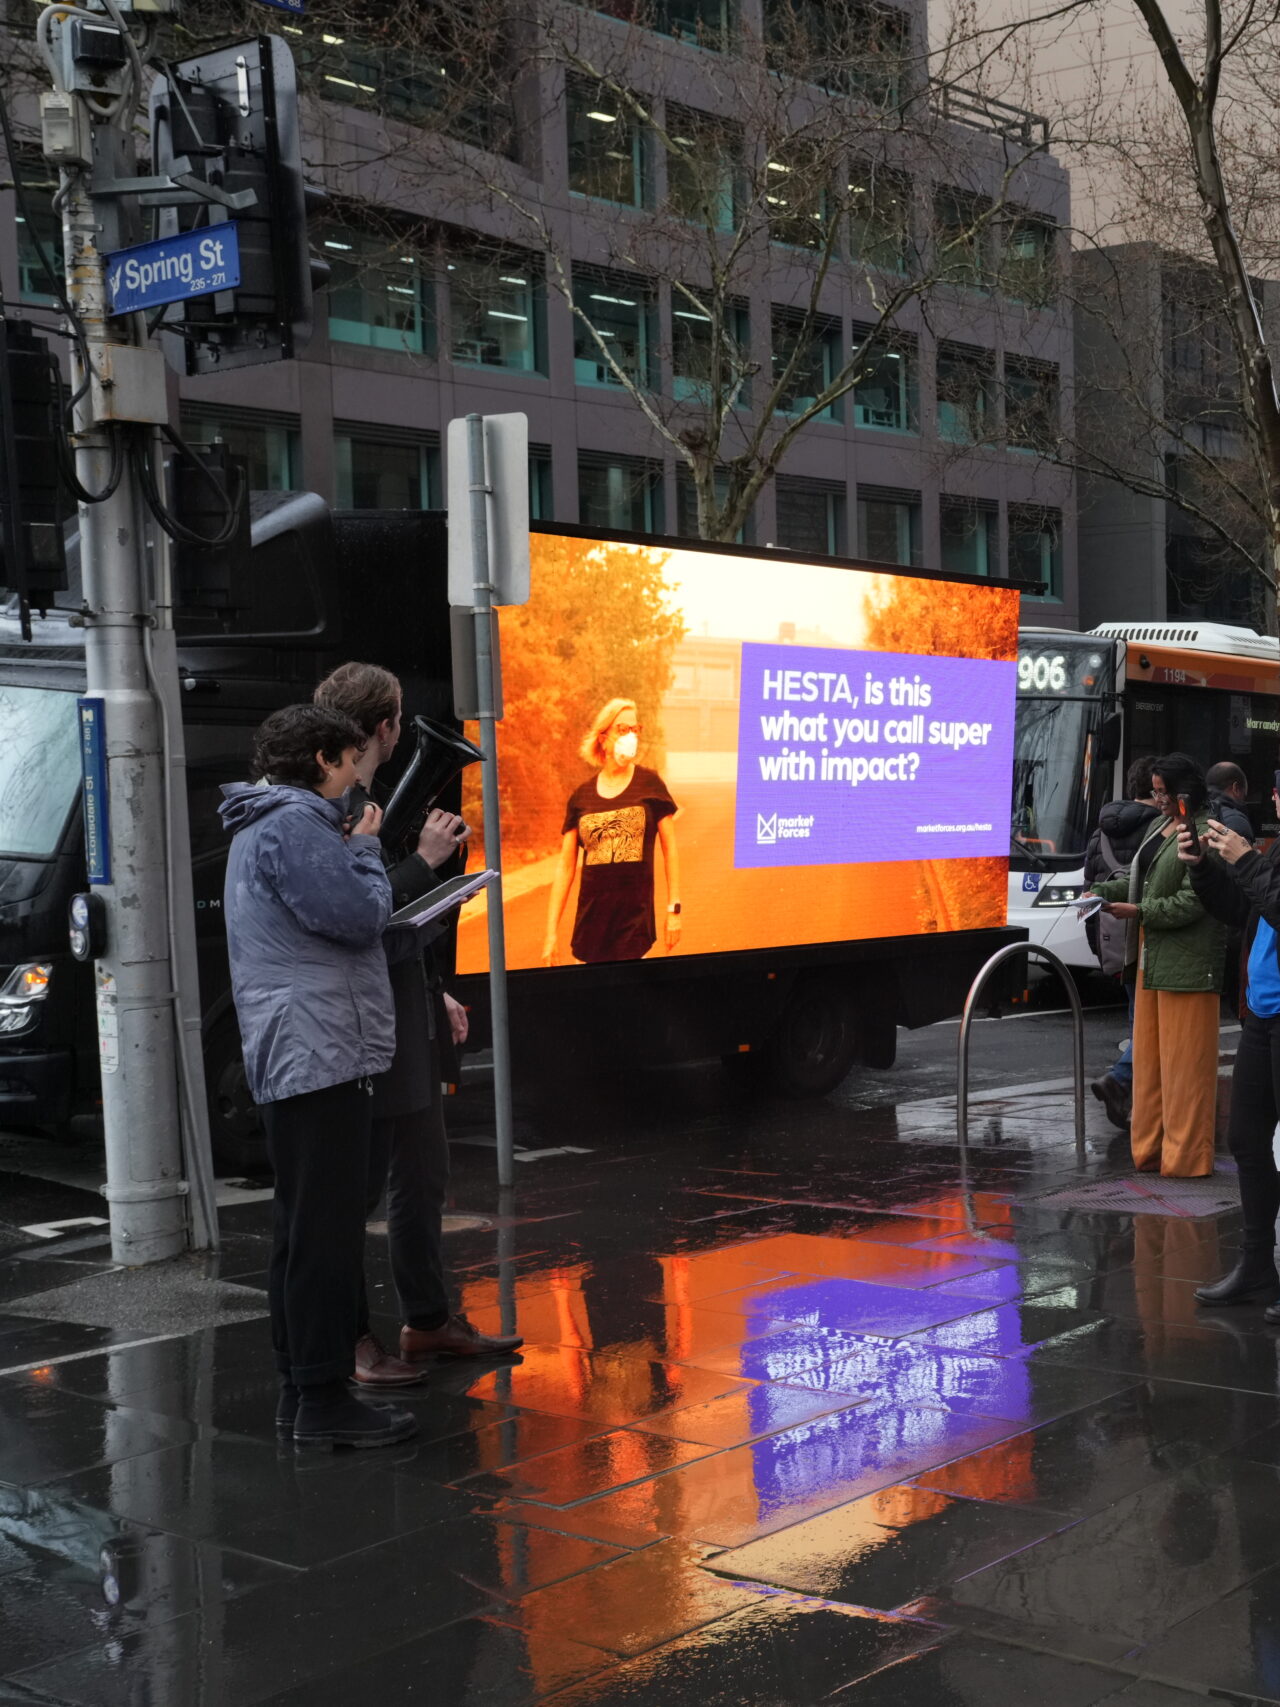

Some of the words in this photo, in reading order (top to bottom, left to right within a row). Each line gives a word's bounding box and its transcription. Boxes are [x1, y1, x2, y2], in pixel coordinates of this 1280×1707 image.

[125, 251, 193, 293] Spring
[199, 239, 225, 270] St
[763, 669, 859, 709] HESTA,
[864, 672, 884, 705] is
[888, 675, 932, 707] this
[1018, 656, 1066, 690] 906
[1164, 668, 1186, 683] 1194
[760, 710, 828, 742] what
[833, 717, 879, 748] you
[884, 715, 924, 744] call
[928, 721, 992, 750] super
[759, 748, 815, 781] with
[821, 748, 920, 787] impact?
[87, 792, 97, 857] Lonsdale
[778, 815, 814, 828] market
[778, 827, 810, 839] forces
